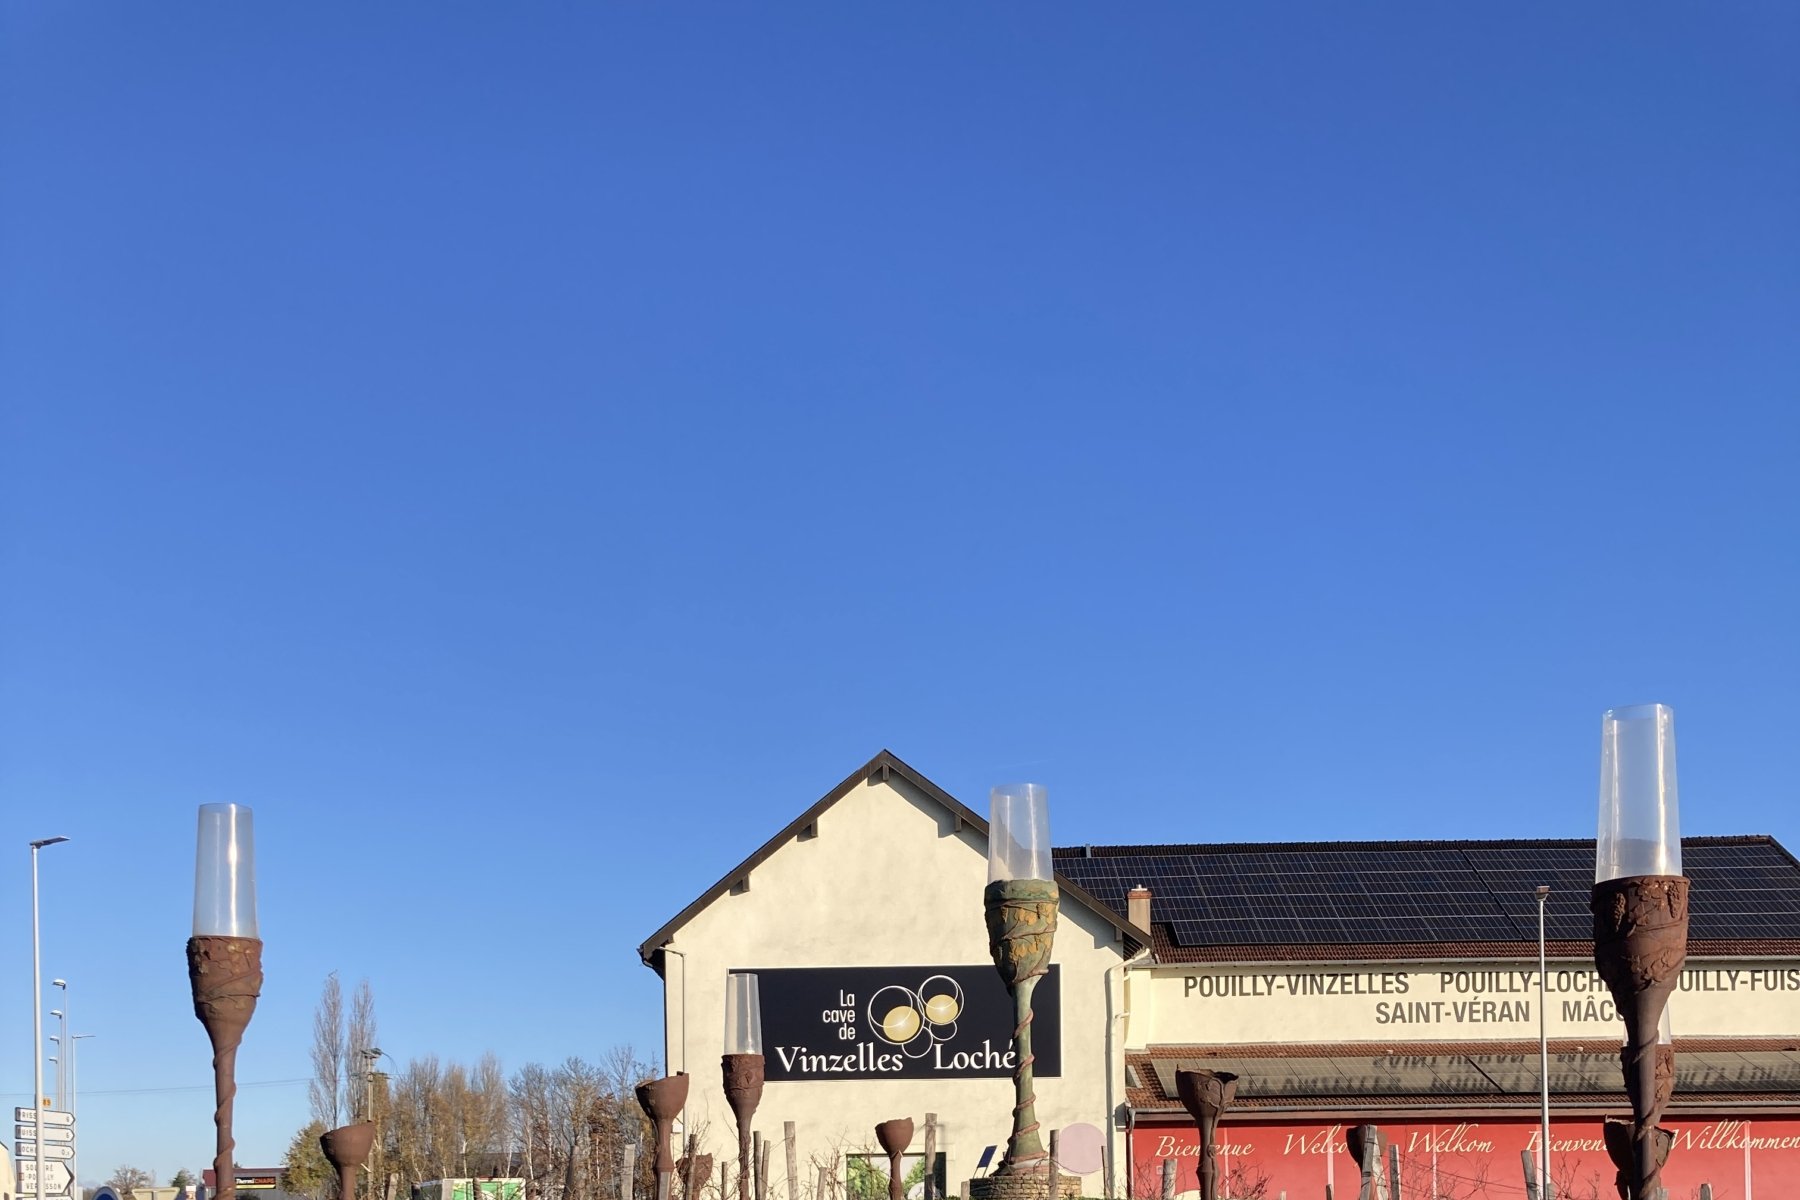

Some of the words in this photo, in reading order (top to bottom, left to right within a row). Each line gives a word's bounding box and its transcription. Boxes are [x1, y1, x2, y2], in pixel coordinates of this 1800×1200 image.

[840, 989, 855, 1007] La
[1184, 972, 1410, 998] POUILLY-VINZELLES
[822, 1009, 856, 1023] cave
[1375, 996, 1530, 1025] SAINT-VÉRAN
[1562, 995, 1625, 1022] MÂC
[838, 1022, 856, 1040] de
[774, 1041, 904, 1073] Vinzelles
[933, 1038, 1016, 1070] Loché
[1407, 1122, 1495, 1154] Welkom
[1670, 1119, 1800, 1150] Willkommen
